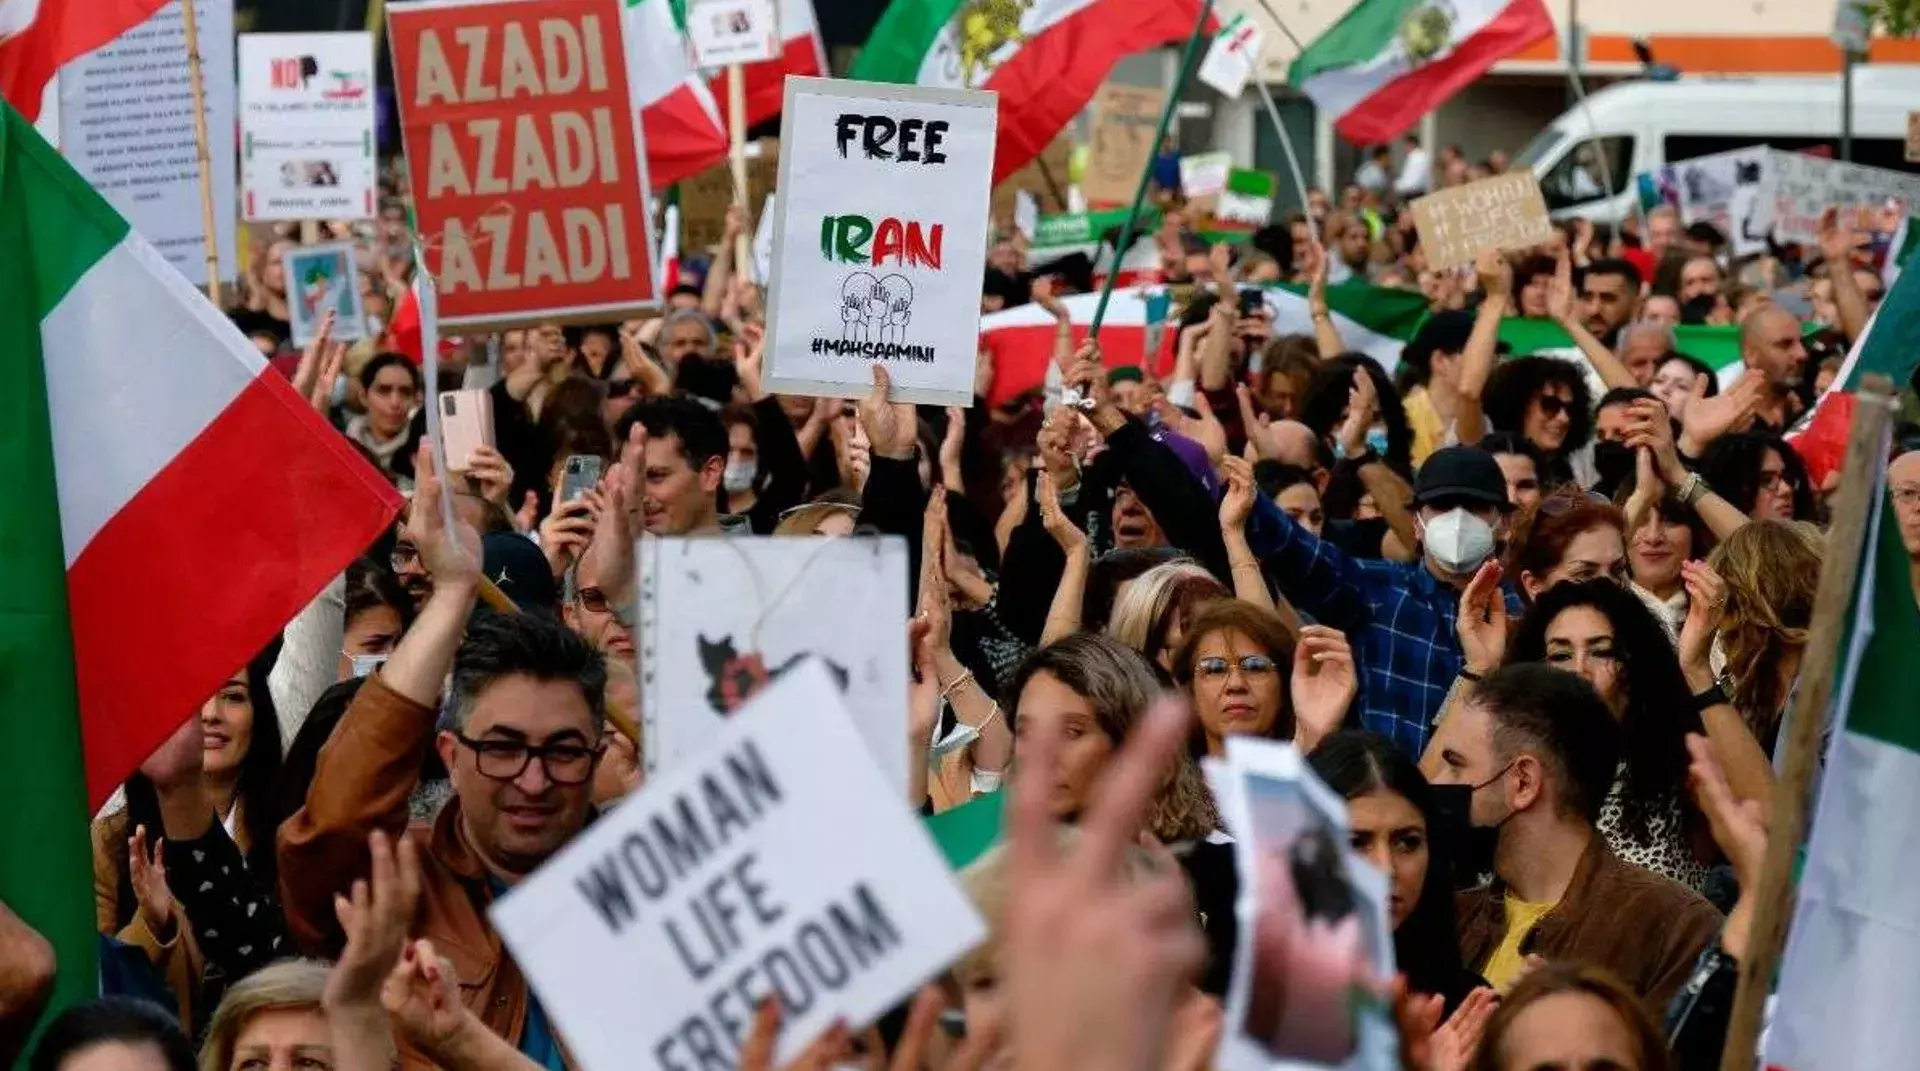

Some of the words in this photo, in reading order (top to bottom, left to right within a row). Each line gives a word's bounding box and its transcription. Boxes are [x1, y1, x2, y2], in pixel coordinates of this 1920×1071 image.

[415, 15, 609, 108] AZADI
[427, 106, 620, 199] AZADI
[834, 113, 950, 165] FREE
[439, 203, 632, 294] AZADI
[820, 214, 943, 270] IRAN
[811, 337, 935, 363] #MAHSAAMINI
[574, 738, 785, 936] WOMAN
[661, 852, 786, 982] LIFE
